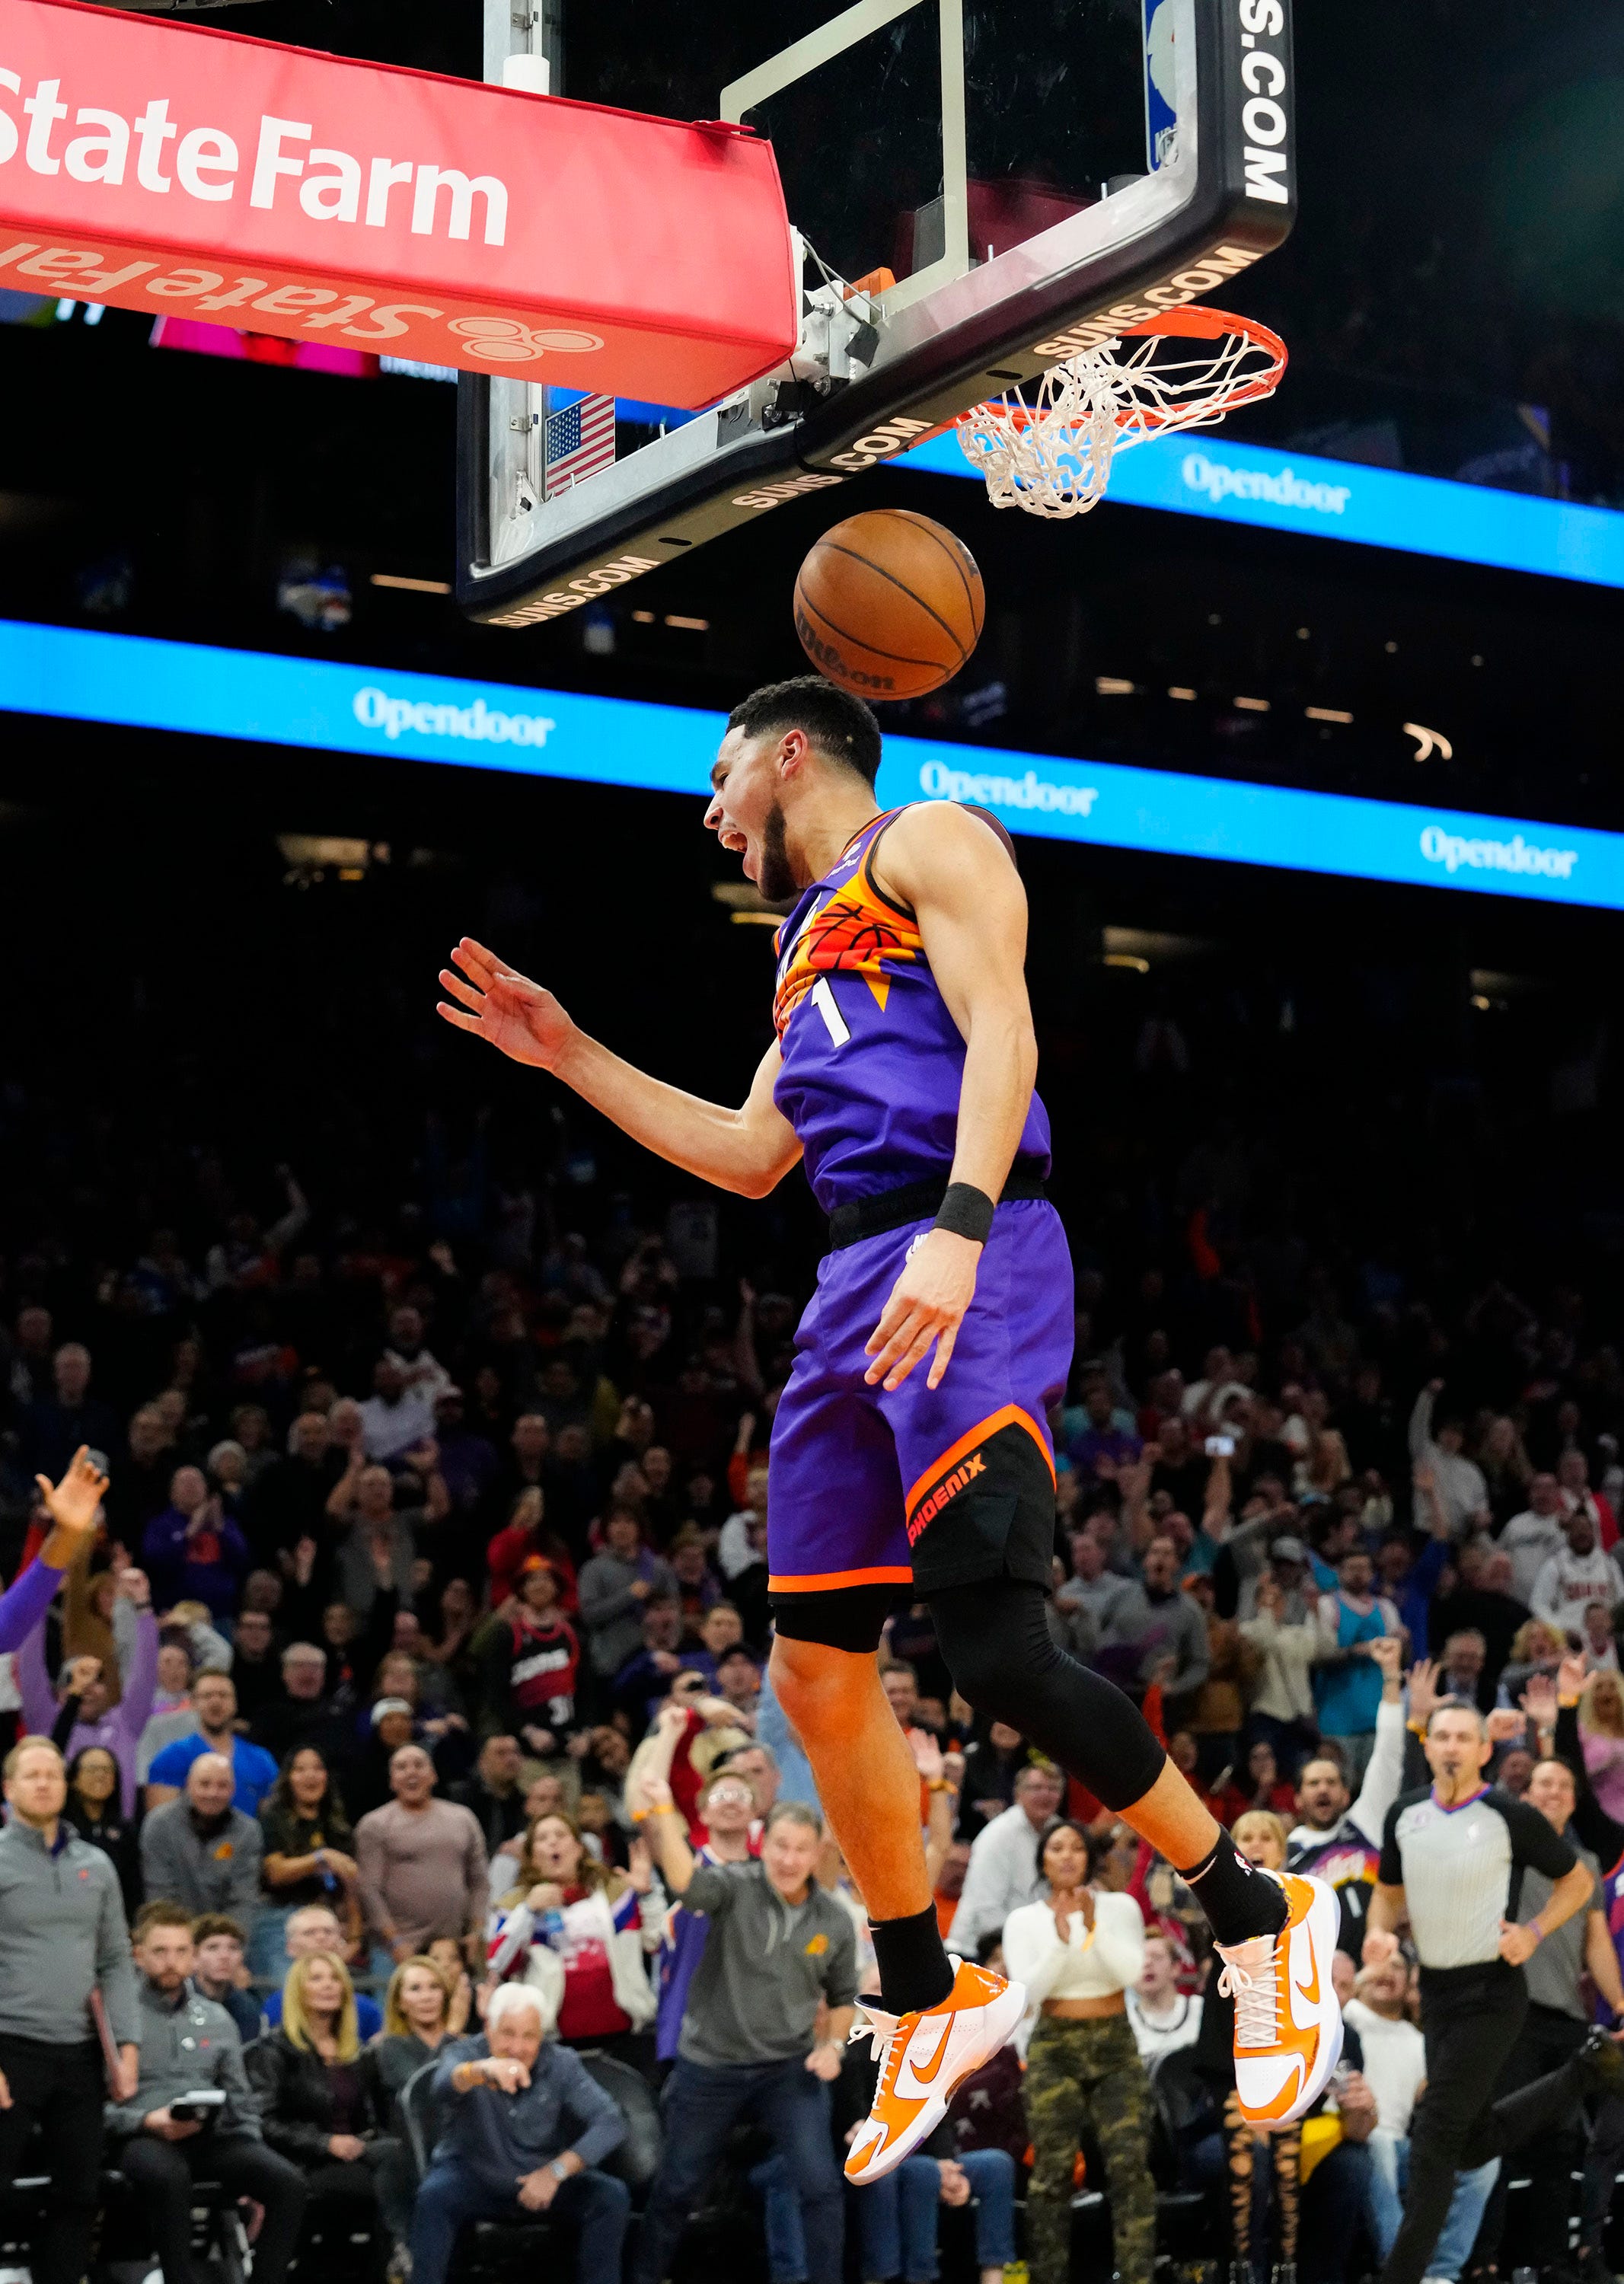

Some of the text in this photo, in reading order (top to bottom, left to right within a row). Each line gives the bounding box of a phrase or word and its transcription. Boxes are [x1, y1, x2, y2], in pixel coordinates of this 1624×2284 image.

[1033, 245, 1264, 359] SUNS.COM
[1182, 452, 1351, 515] Opendoor
[488, 555, 661, 627] SUNS.COM
[353, 686, 557, 748] Opendoor
[919, 760, 1099, 818] Opendoor
[1420, 825, 1578, 880] Opendoor
[811, 975, 852, 1049] 1
[907, 1453, 987, 1549] PHOENIX
